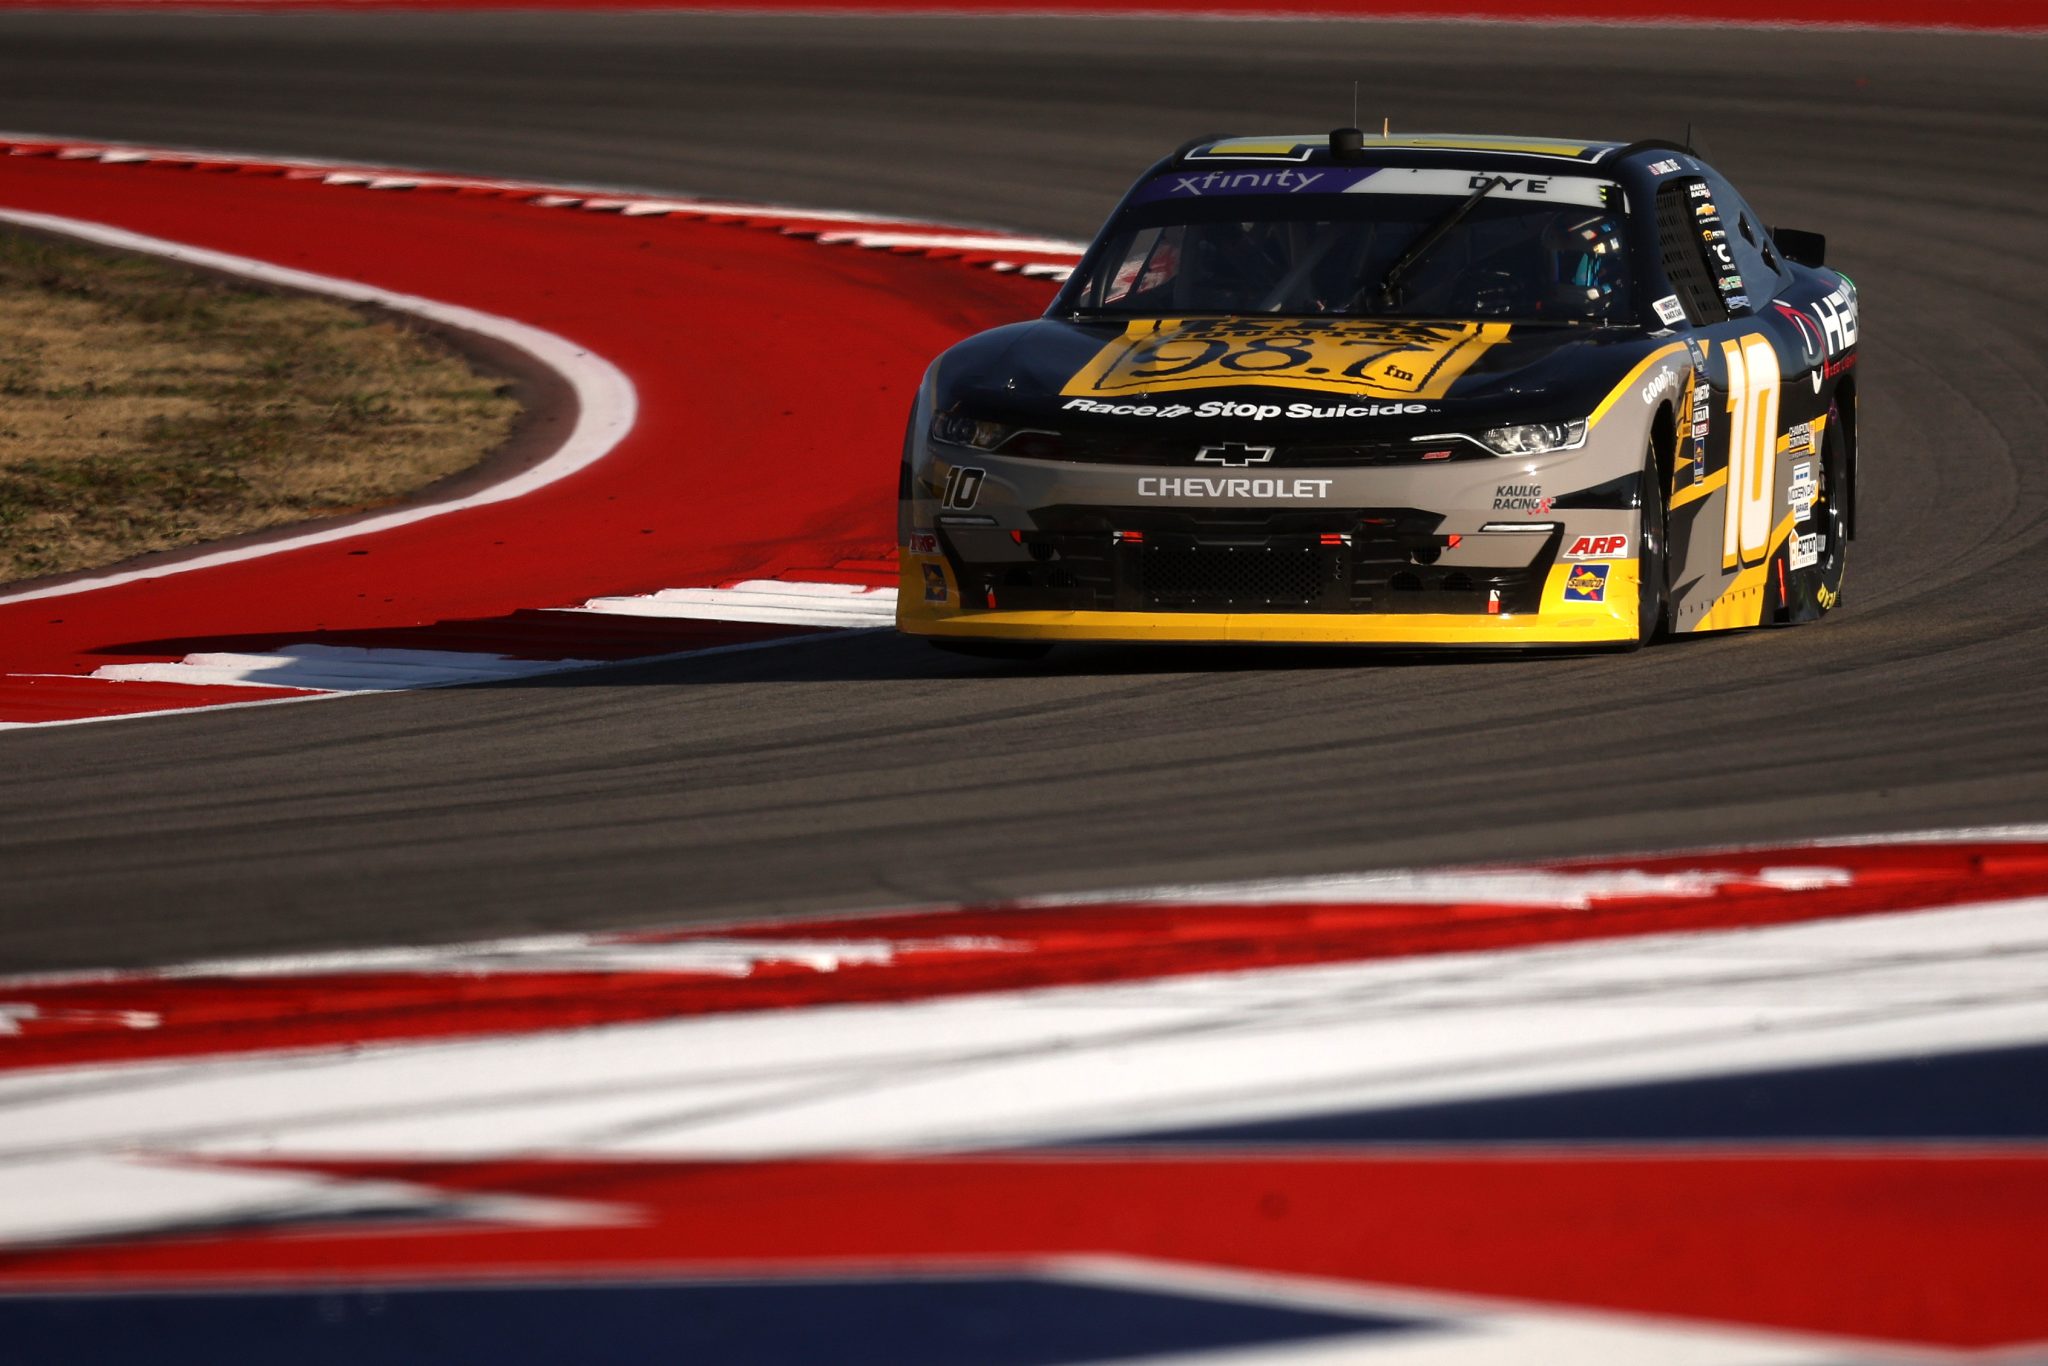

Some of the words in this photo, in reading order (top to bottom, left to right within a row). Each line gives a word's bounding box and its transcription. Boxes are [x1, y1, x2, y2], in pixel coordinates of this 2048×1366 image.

[1171, 169, 1325, 196] xfinity
[1469, 176, 1550, 194] DYE
[1130, 337, 1435, 381] 98.7
[1384, 364, 1414, 382] fm
[1061, 398, 1158, 417] Race
[1194, 401, 1282, 421] Stop
[1285, 403, 1427, 419] Suicide
[1720, 333, 1781, 572] 10
[942, 465, 986, 511] 10
[1138, 477, 1333, 498] CHEVROLET
[1496, 485, 1542, 497] KAULIG
[1492, 498, 1541, 510] RACING
[1569, 536, 1627, 555] ARP
